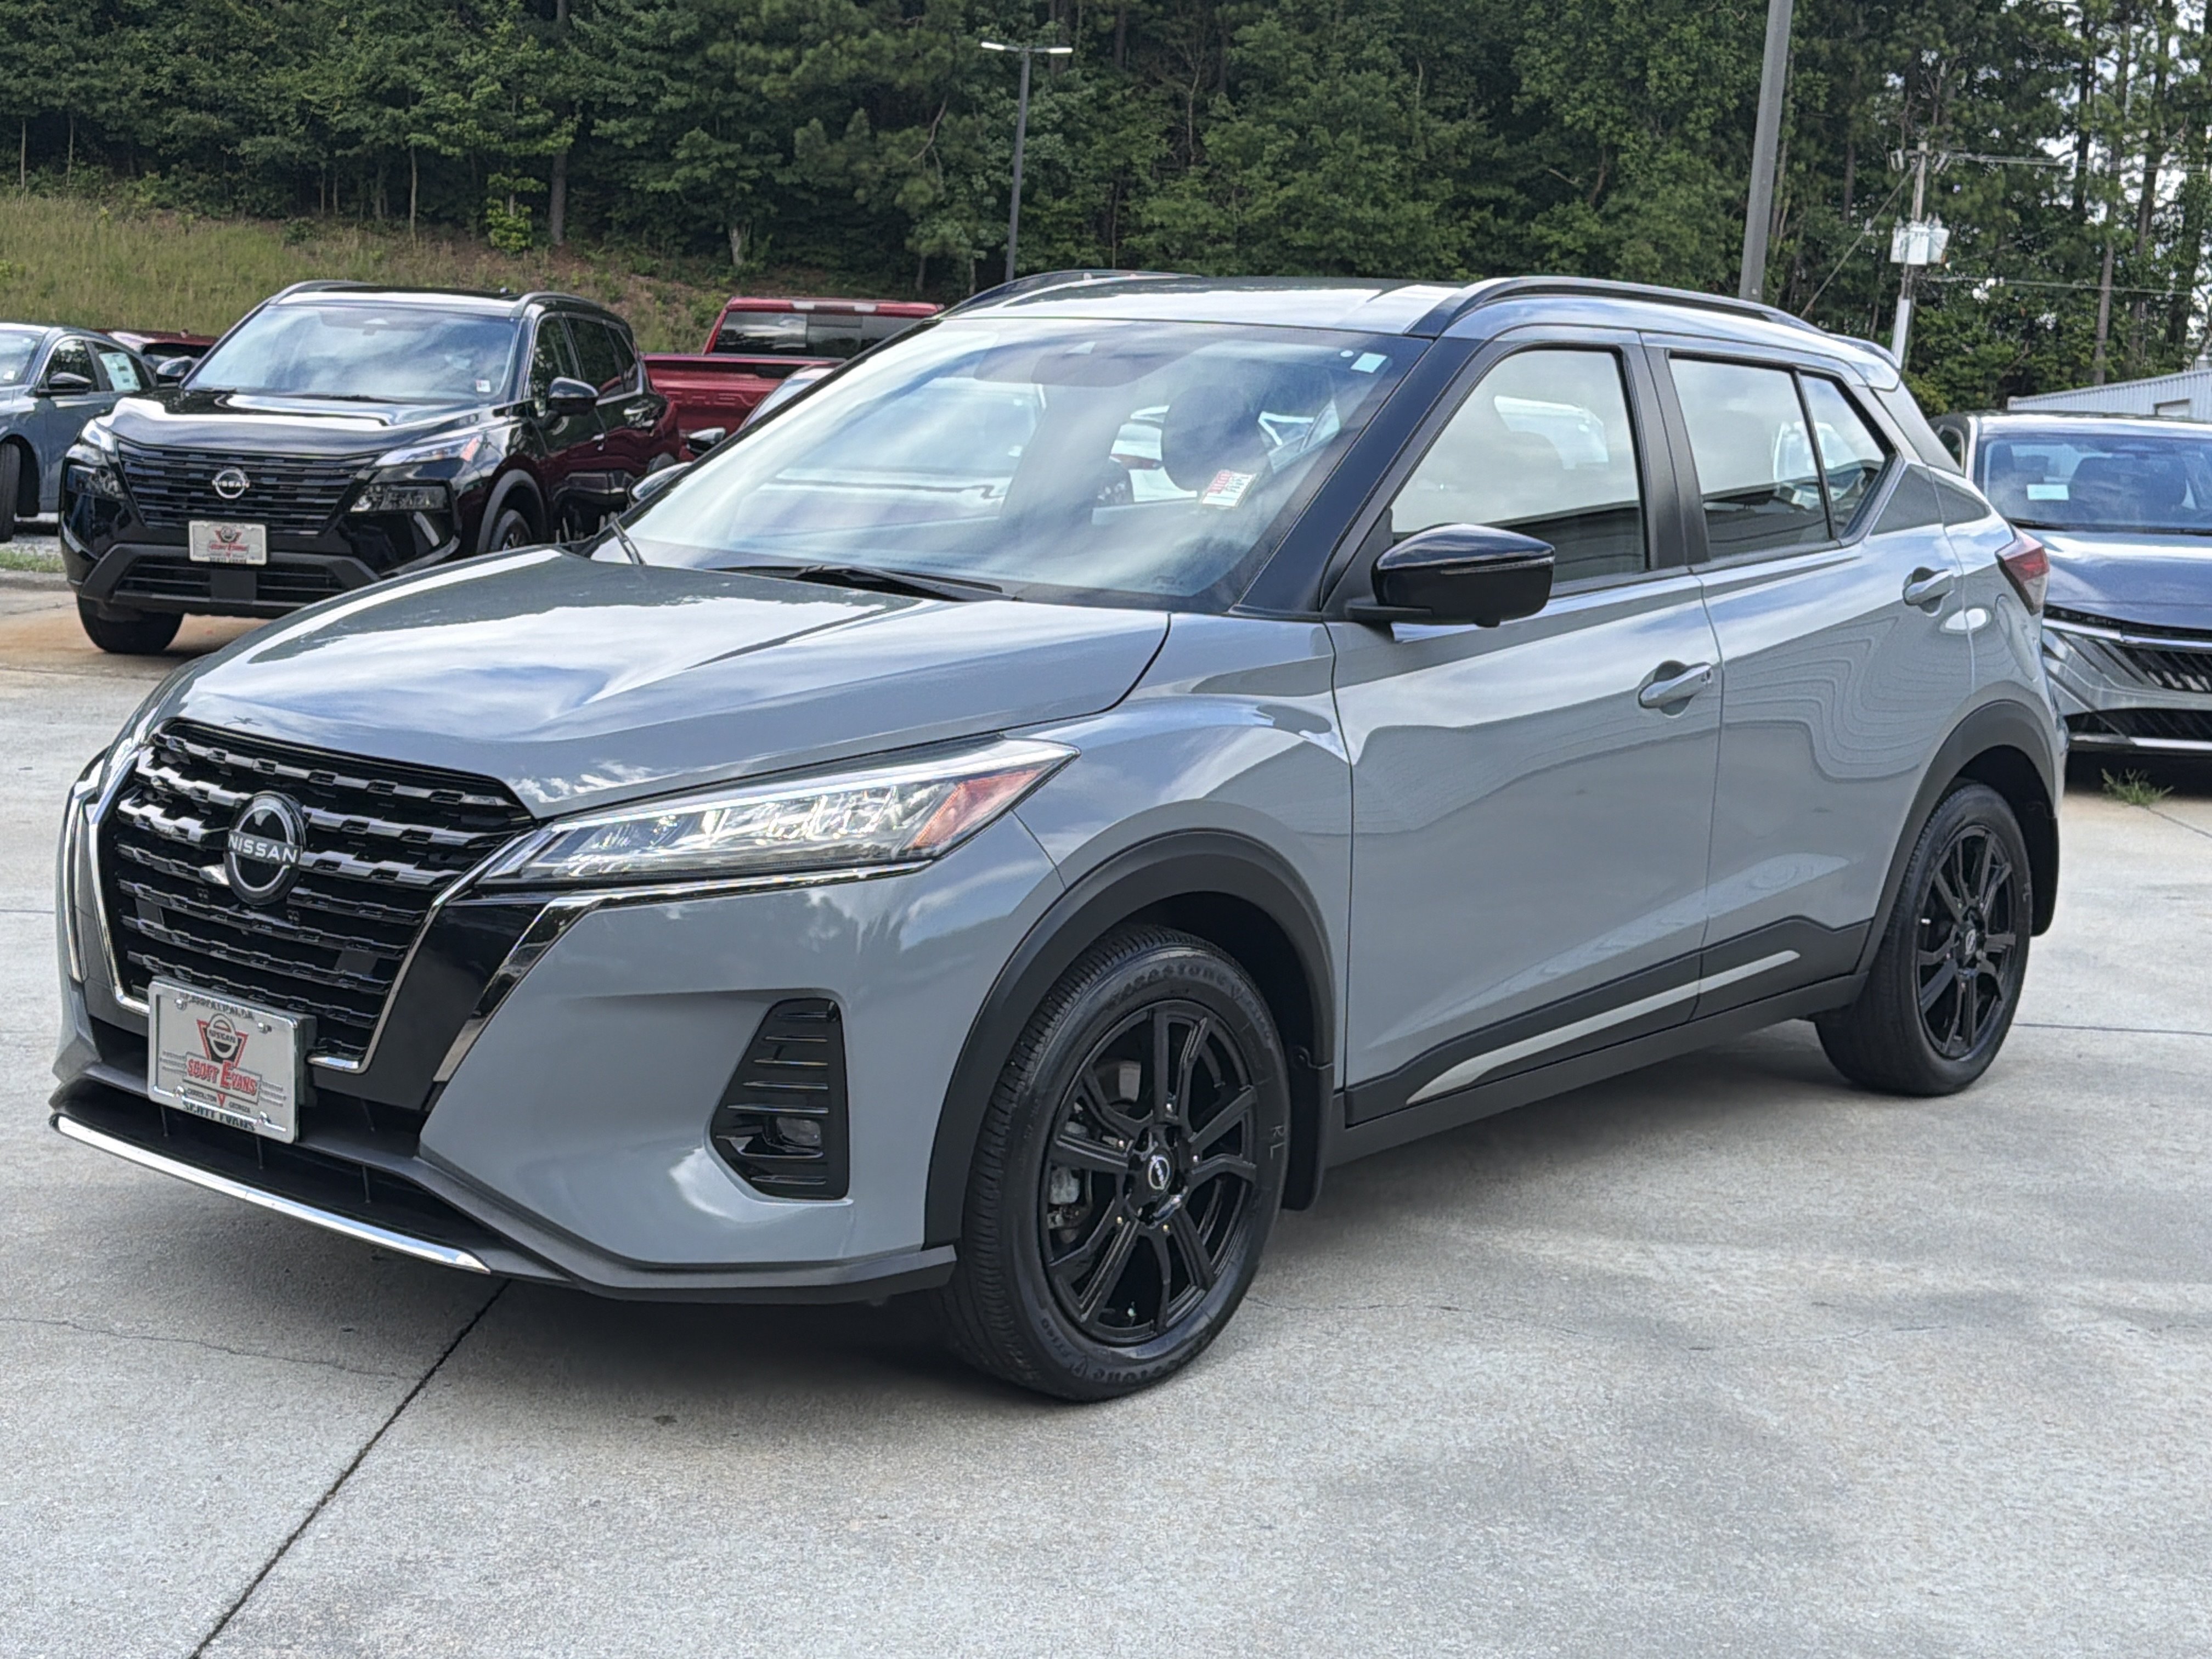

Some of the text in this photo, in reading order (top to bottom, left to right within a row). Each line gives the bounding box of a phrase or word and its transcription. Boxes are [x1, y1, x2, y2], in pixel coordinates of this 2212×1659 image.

[228, 833, 298, 863] NISSAN
[188, 1058, 258, 1097] SCOTT EVANS
